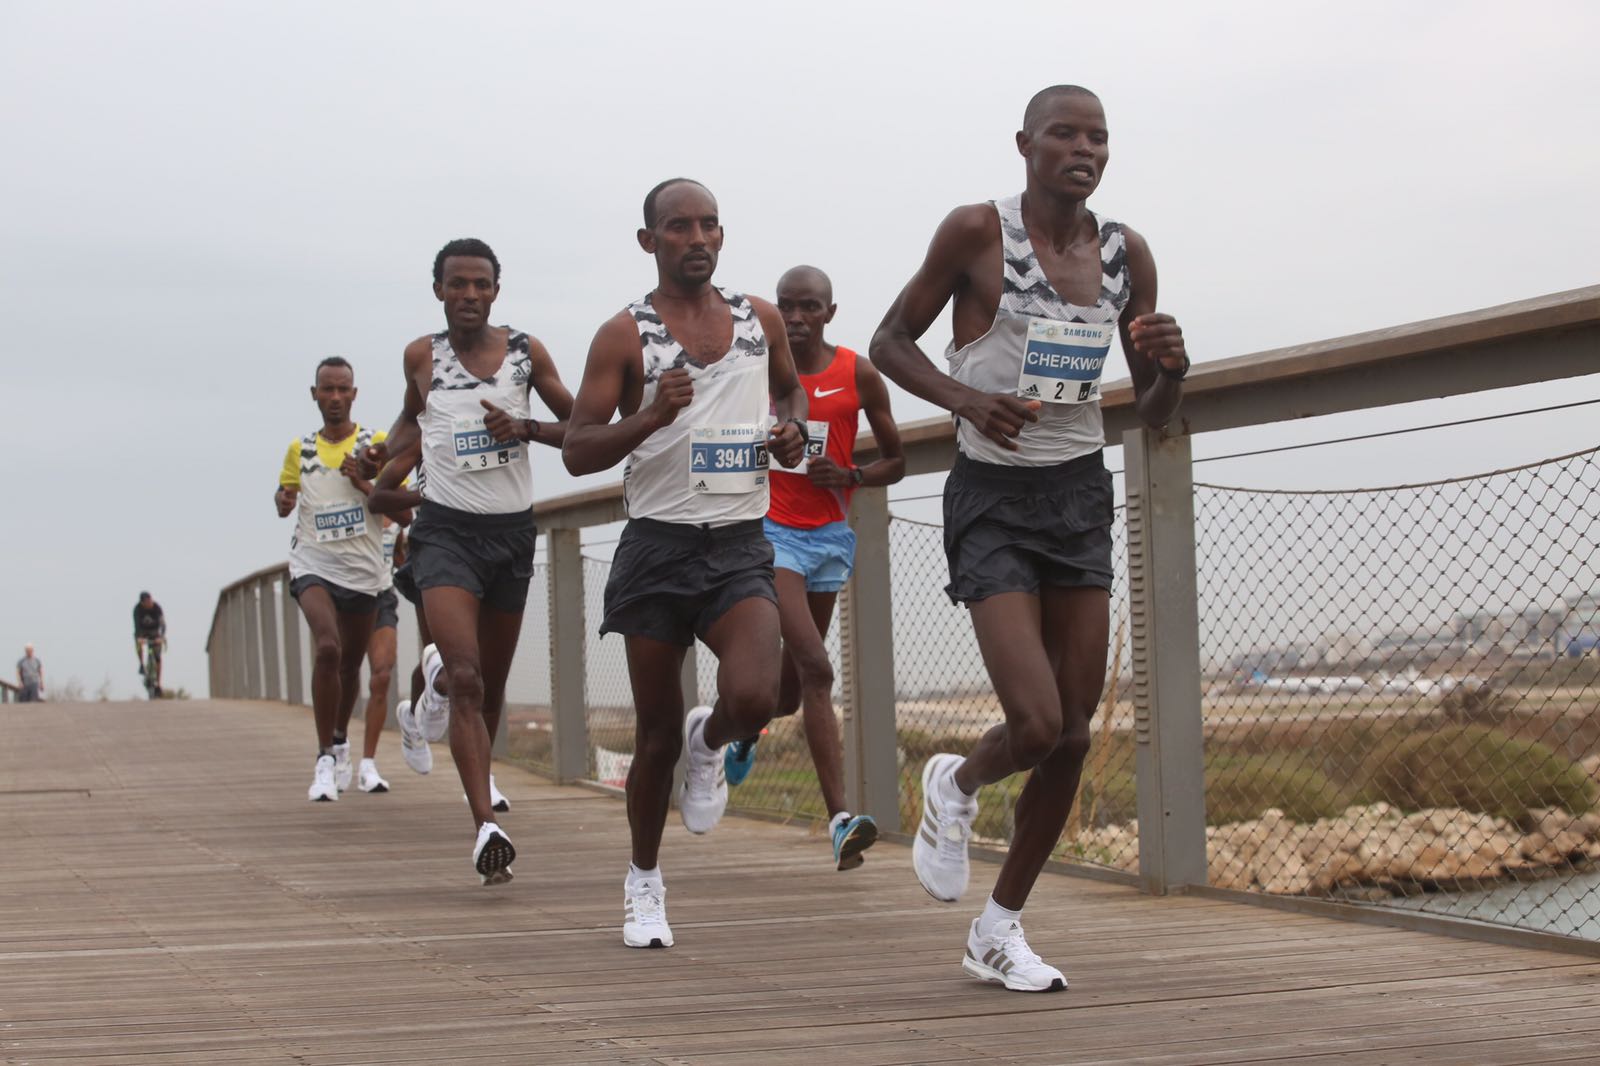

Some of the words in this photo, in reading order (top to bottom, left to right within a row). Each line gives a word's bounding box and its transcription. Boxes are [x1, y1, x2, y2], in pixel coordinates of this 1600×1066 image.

[1054, 381, 1064, 399] 2
[480, 454, 487, 467] 3
[693, 451, 706, 465] A
[715, 448, 750, 468] 3941
[317, 510, 362, 528] BIRATU
